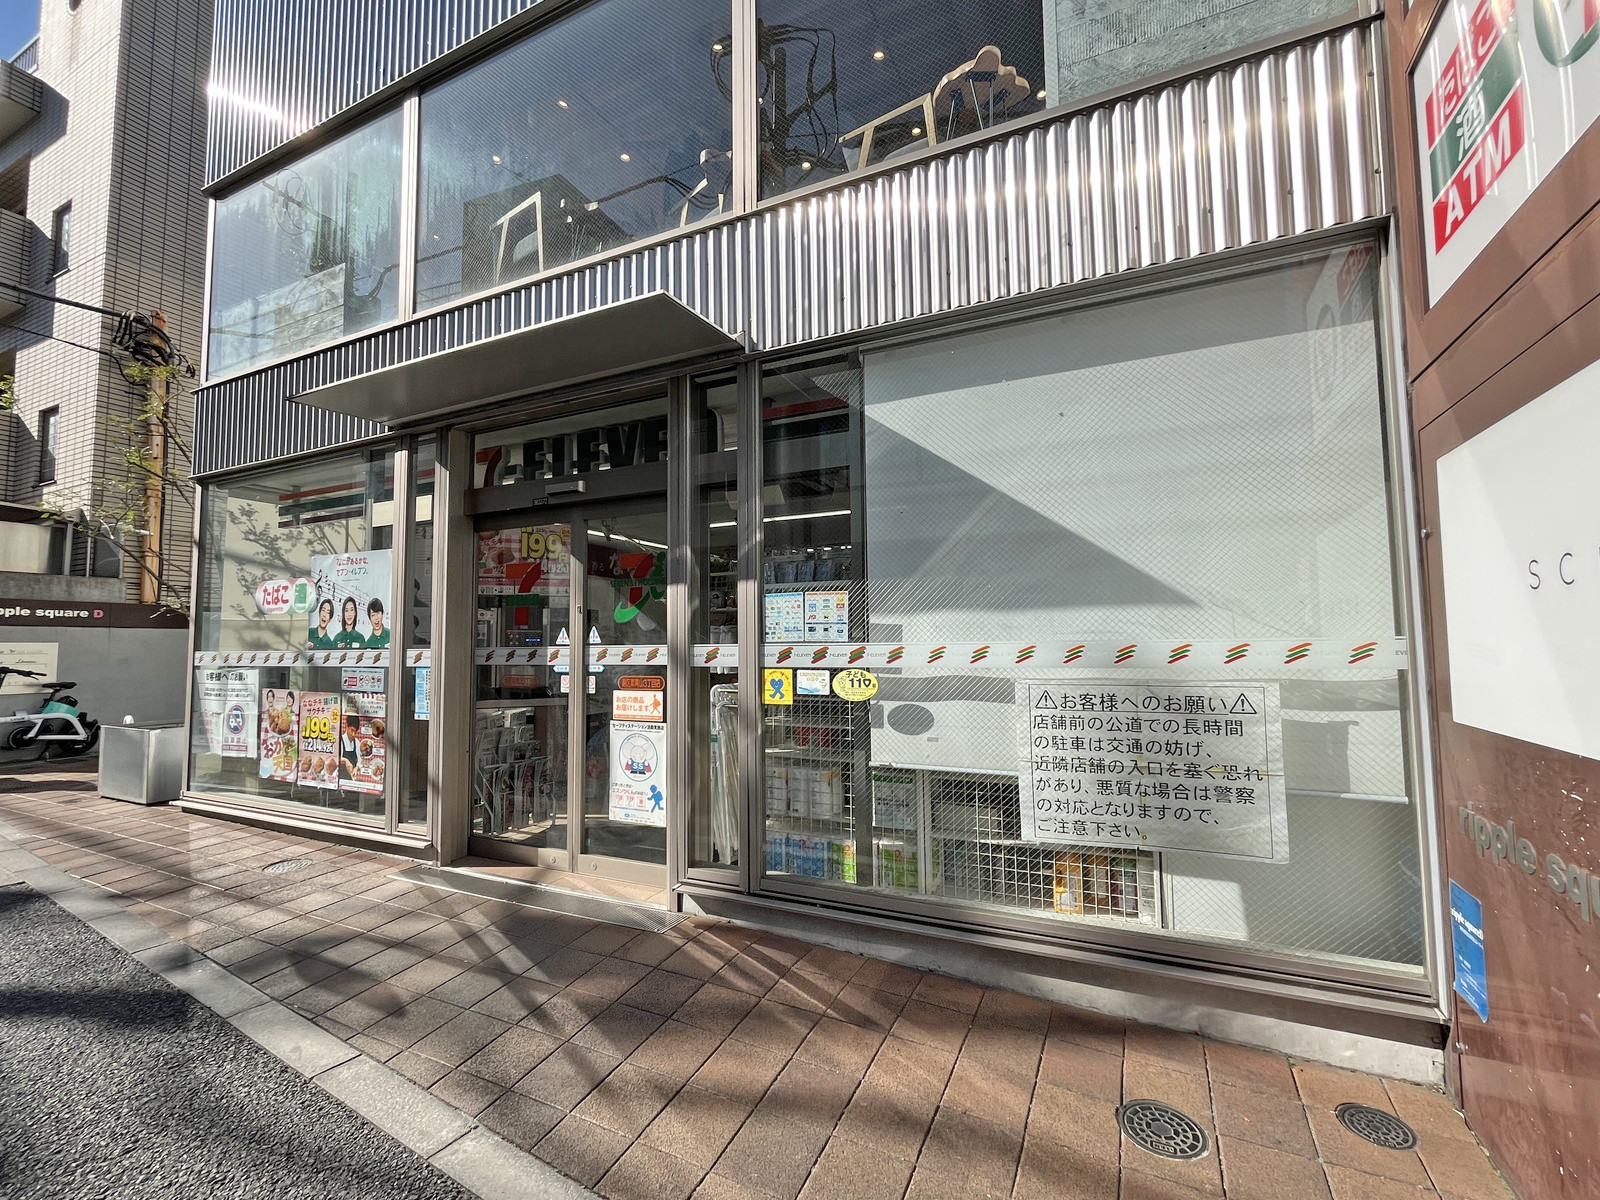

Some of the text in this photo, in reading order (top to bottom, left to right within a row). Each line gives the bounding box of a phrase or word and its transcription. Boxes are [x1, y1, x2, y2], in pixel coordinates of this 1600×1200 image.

[1455, 78, 1486, 161] 酒
[1445, 109, 1512, 239] ATM
[1528, 547, 1600, 590] SC
[262, 584, 289, 606] たばこ
[35, 610, 89, 618] square
[93, 610, 104, 618] D
[616, 696, 645, 704] お店の商品
[1059, 692, 1227, 714] お客様へのお願い
[1033, 714, 1244, 737] 店舗前の公道での長時間
[1034, 735, 1212, 758] の駐車は交通の妨げ、
[1034, 755, 1264, 782] 近隣店舗の入口を塞ぐ恐れ
[1036, 777, 1256, 805] があり、悪質な場合は警察
[1037, 798, 1219, 825] の対応となりますので、
[1037, 818, 1148, 841] ご注意下さい。
[1459, 801, 1537, 875] ripple
